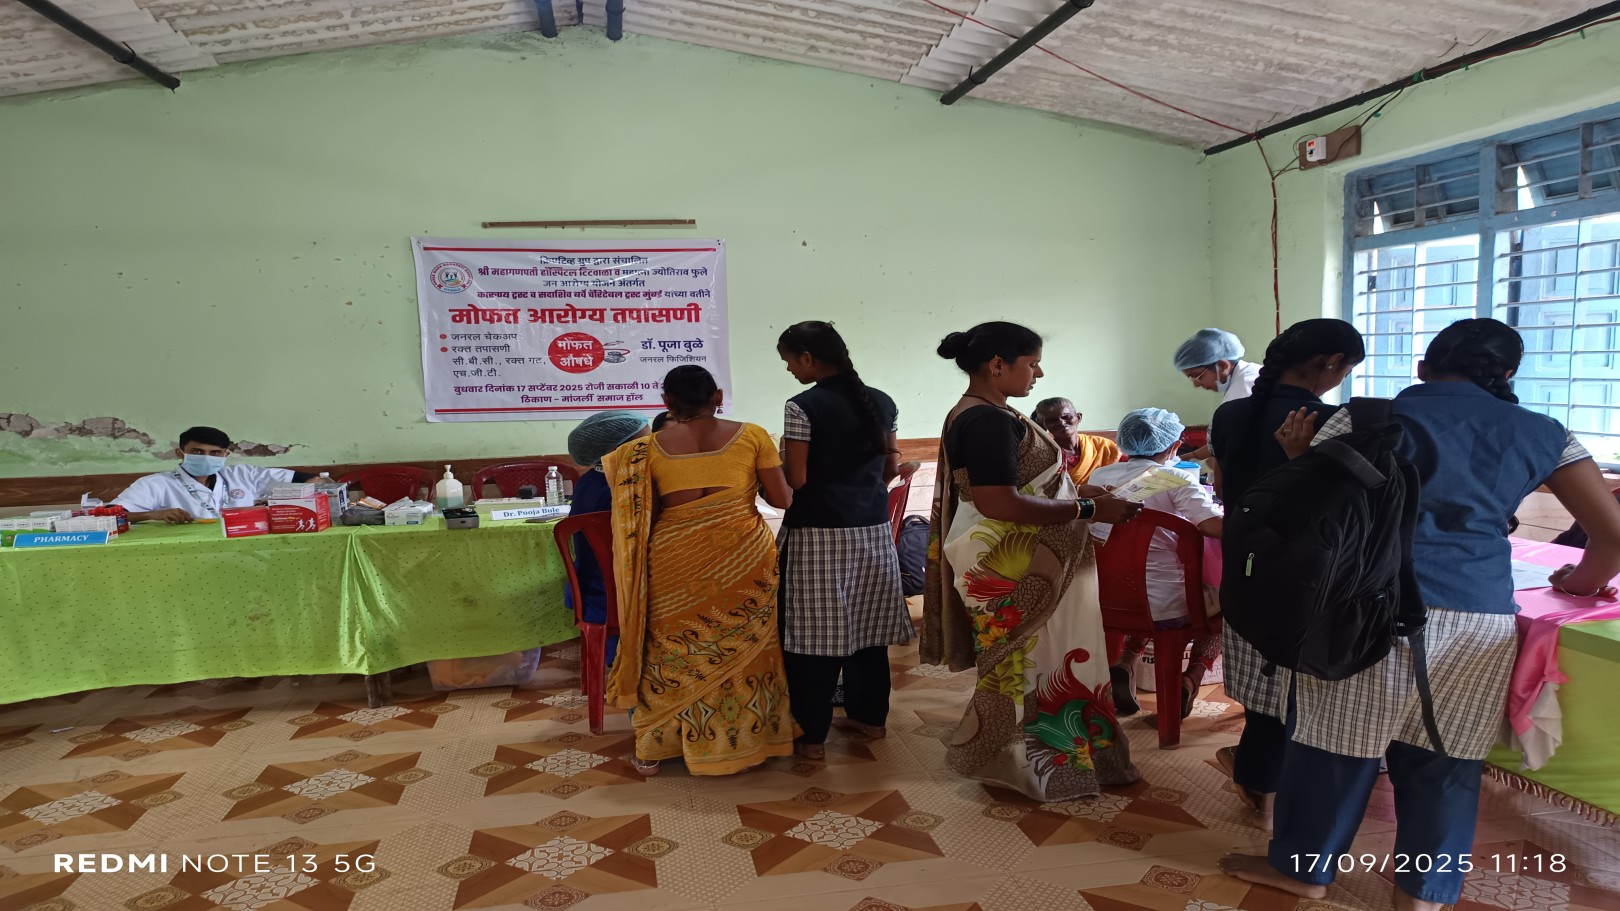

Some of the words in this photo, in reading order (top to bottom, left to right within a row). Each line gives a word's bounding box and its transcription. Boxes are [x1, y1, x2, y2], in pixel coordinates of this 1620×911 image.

[612, 255, 648, 265] संचालित
[478, 265, 489, 276] श्री
[491, 266, 538, 276] महागणपती
[540, 266, 577, 277] हॉस्पिटल
[579, 266, 612, 277] टिटवाळा
[614, 268, 621, 276] व
[652, 266, 689, 276] ज्योतिराव
[691, 266, 708, 278] फुले
[542, 280, 558, 288] जन
[618, 278, 645, 288] अंतर्गत
[511, 291, 528, 300] ट्रस्ट
[530, 291, 537, 299] व
[538, 289, 572, 299] सदाशिव
[625, 290, 641, 299] ट्रस्ट
[664, 289, 687, 298] यांच्या
[690, 288, 711, 298] वतीने
[448, 303, 521, 324] मोफत
[527, 303, 607, 324] आरोग्य
[610, 302, 702, 324] तपासणी
[451, 333, 481, 341] जनरल
[484, 331, 518, 341] चेकअप
[451, 345, 472, 353] रक्त
[475, 343, 511, 353] तपासणी
[557, 338, 593, 350] मोफत
[640, 337, 656, 350] डॉ.
[657, 340, 681, 353] पूजा
[683, 337, 704, 353] बुळे
[505, 357, 525, 365] रक्त
[666, 354, 706, 363] फिजिशियन
[454, 385, 483, 396] बुधवार
[485, 383, 515, 393] दिनांक
[559, 384, 583, 392] 2025
[585, 381, 604, 391] रोजी
[606, 381, 639, 391] सकाळी
[641, 382, 650, 390] 10
[652, 380, 659, 390] ते
[521, 394, 552, 404] ठिकाण
[596, 393, 624, 402] समाज
[625, 392, 643, 402] हॉल
[503, 510, 516, 518] Dr.
[518, 508, 540, 518] Pooja
[542, 506, 560, 515] Bule
[34, 534, 89, 543] PHARMACY
